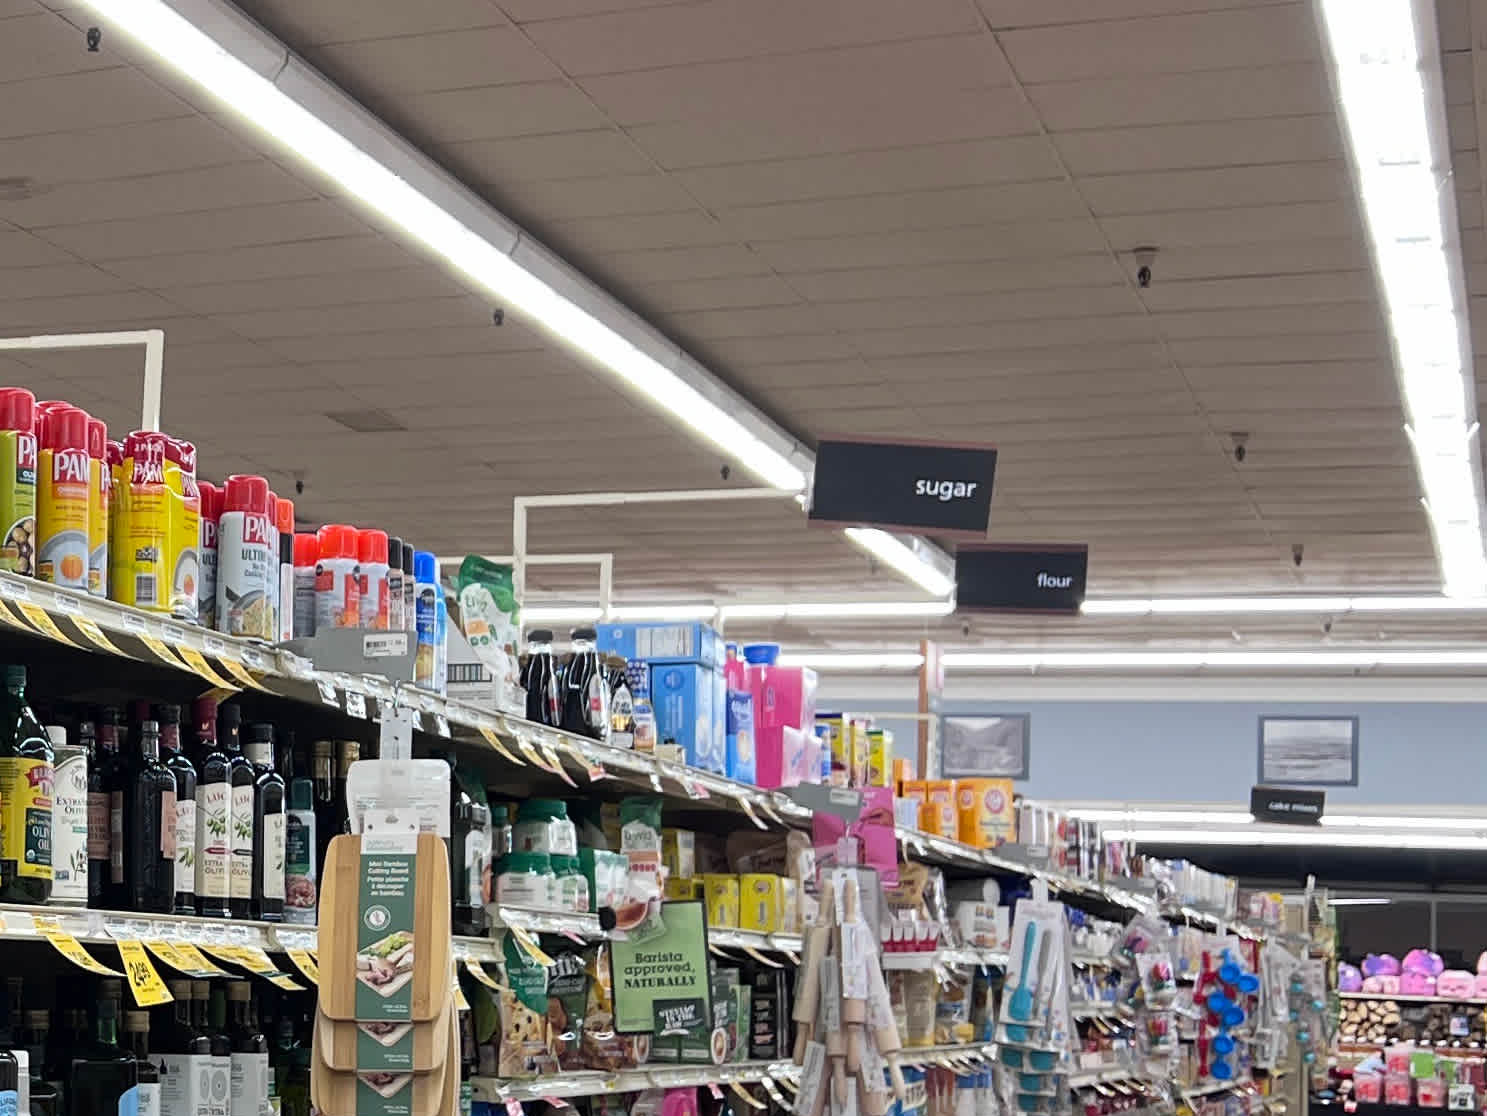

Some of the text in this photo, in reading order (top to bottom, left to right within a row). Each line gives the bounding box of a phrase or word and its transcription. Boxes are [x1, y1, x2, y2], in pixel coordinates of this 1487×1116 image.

[916, 479, 976, 500] sugar
[1037, 572, 1072, 588] flour
[635, 951, 684, 964] Barista
[624, 962, 696, 977] approved,
[624, 975, 697, 989] NATURALLY
